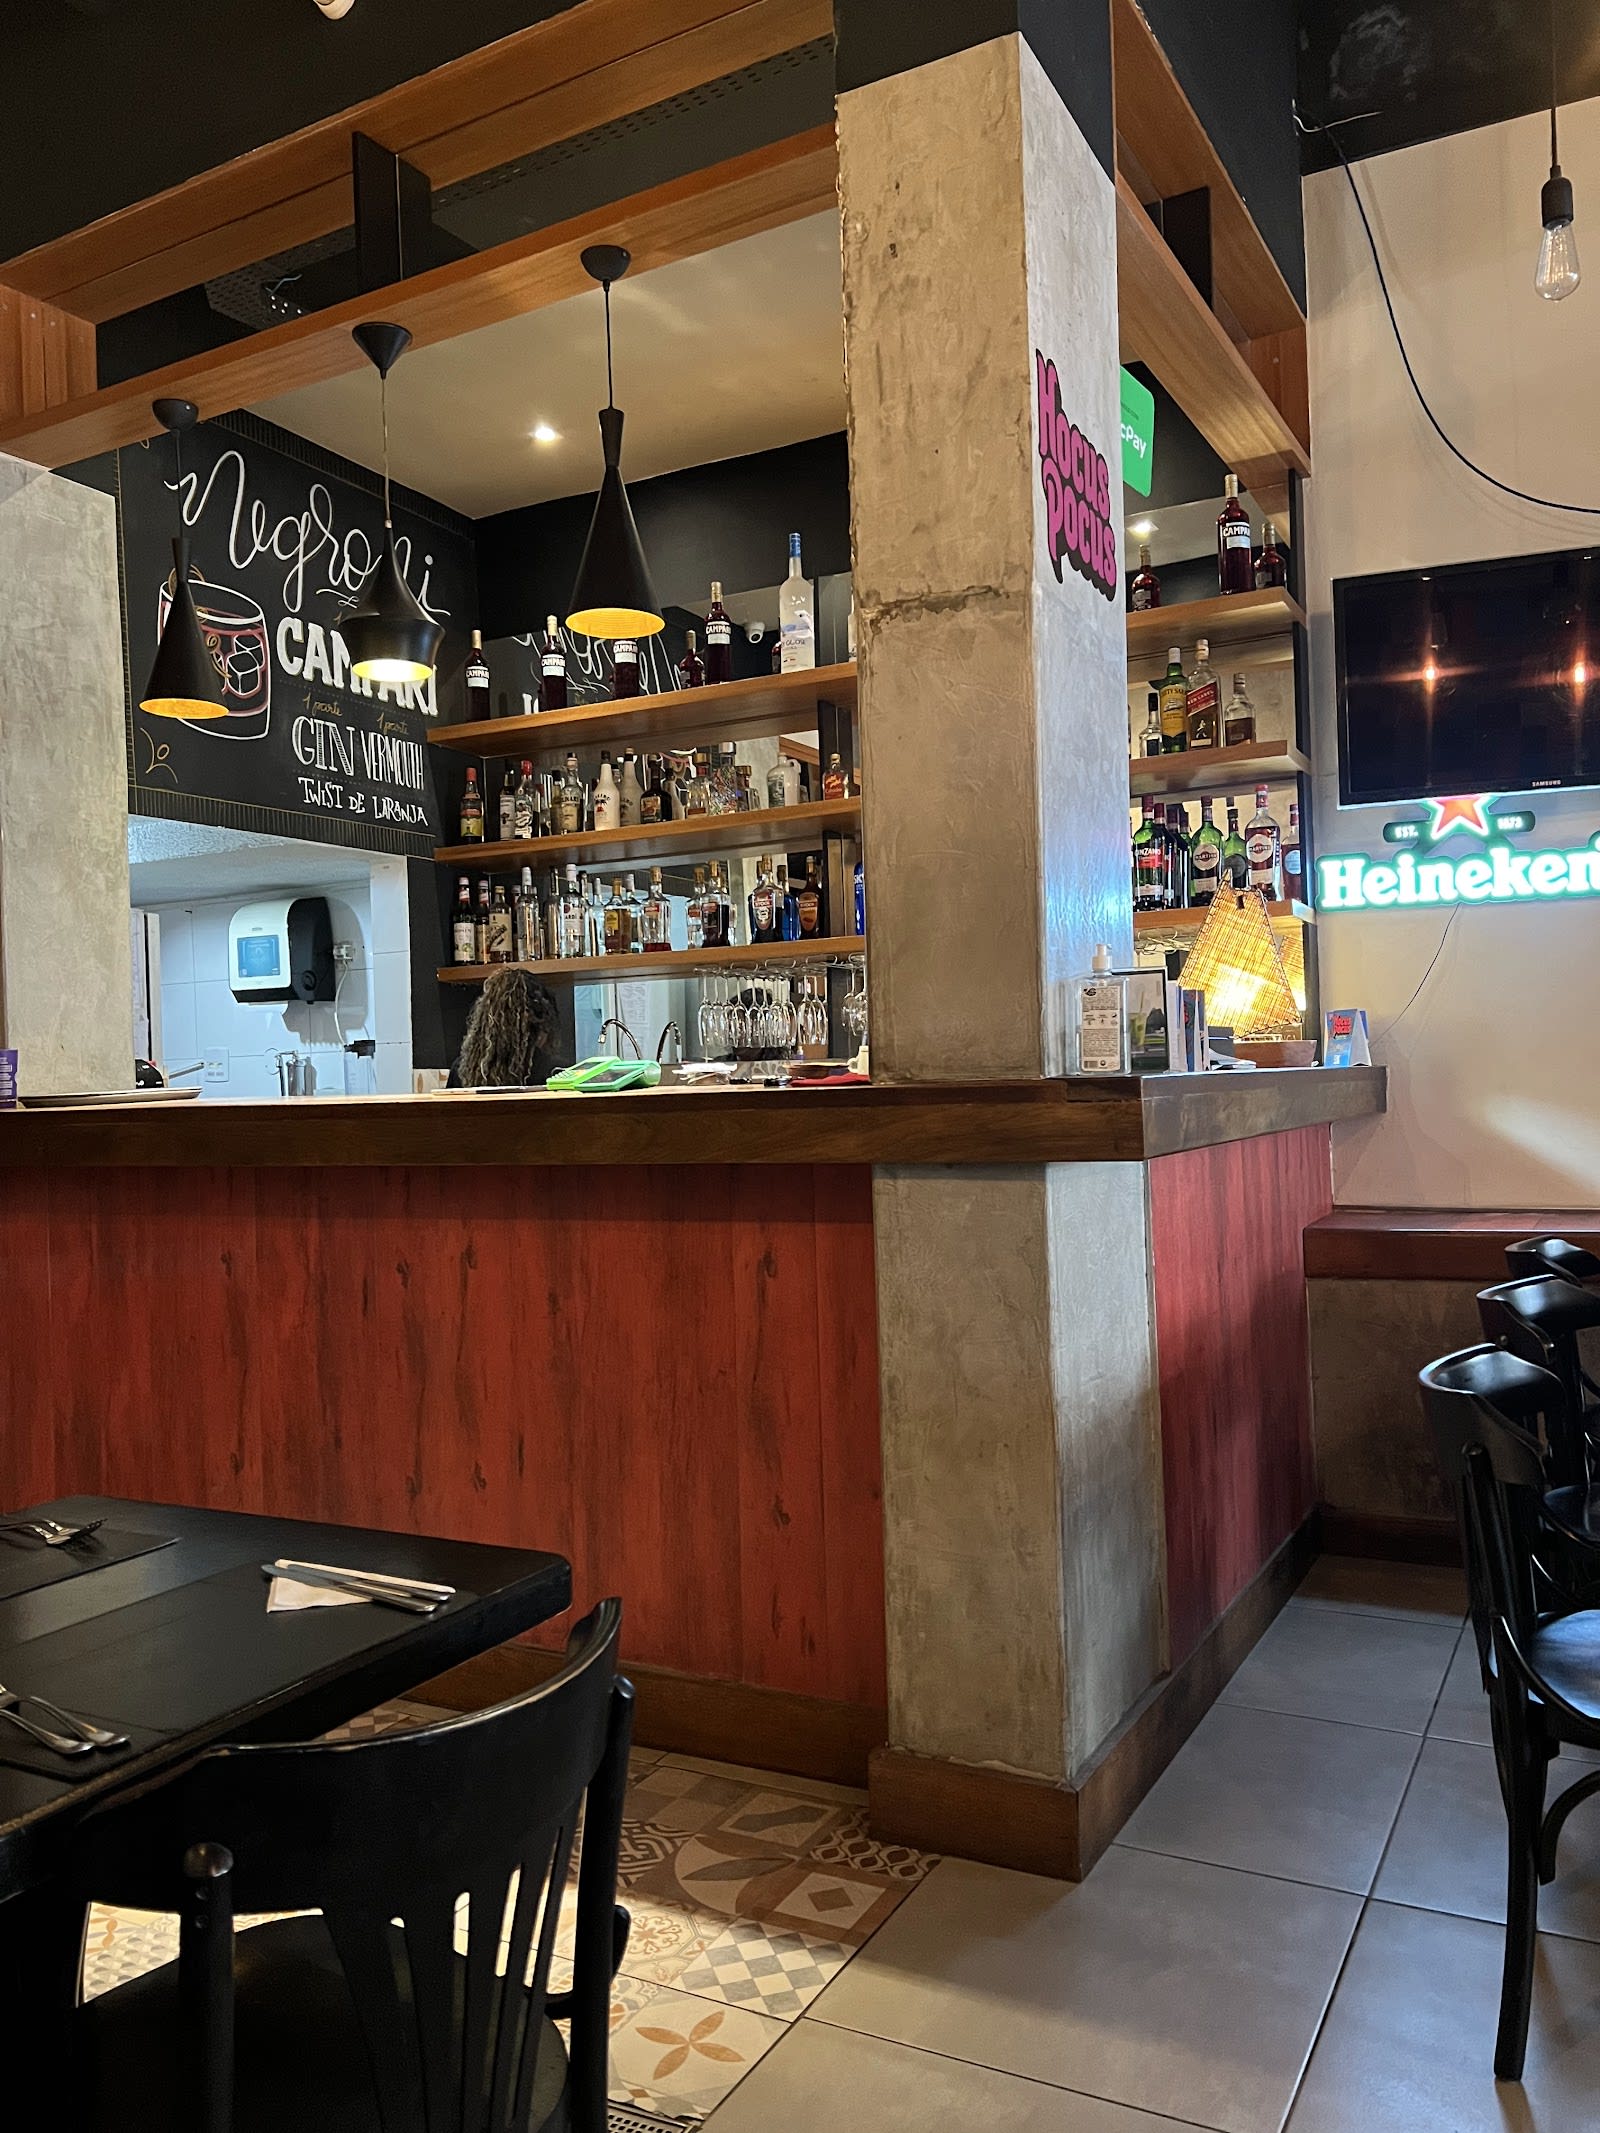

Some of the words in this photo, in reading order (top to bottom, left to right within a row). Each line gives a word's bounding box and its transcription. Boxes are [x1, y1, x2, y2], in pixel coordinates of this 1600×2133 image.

[1120, 423, 1147, 459] cPay
[292, 716, 355, 776] GIN
[360, 730, 424, 791] VERMOUTH
[372, 796, 429, 827] LARANJA
[1320, 847, 1600, 908] Heineken
